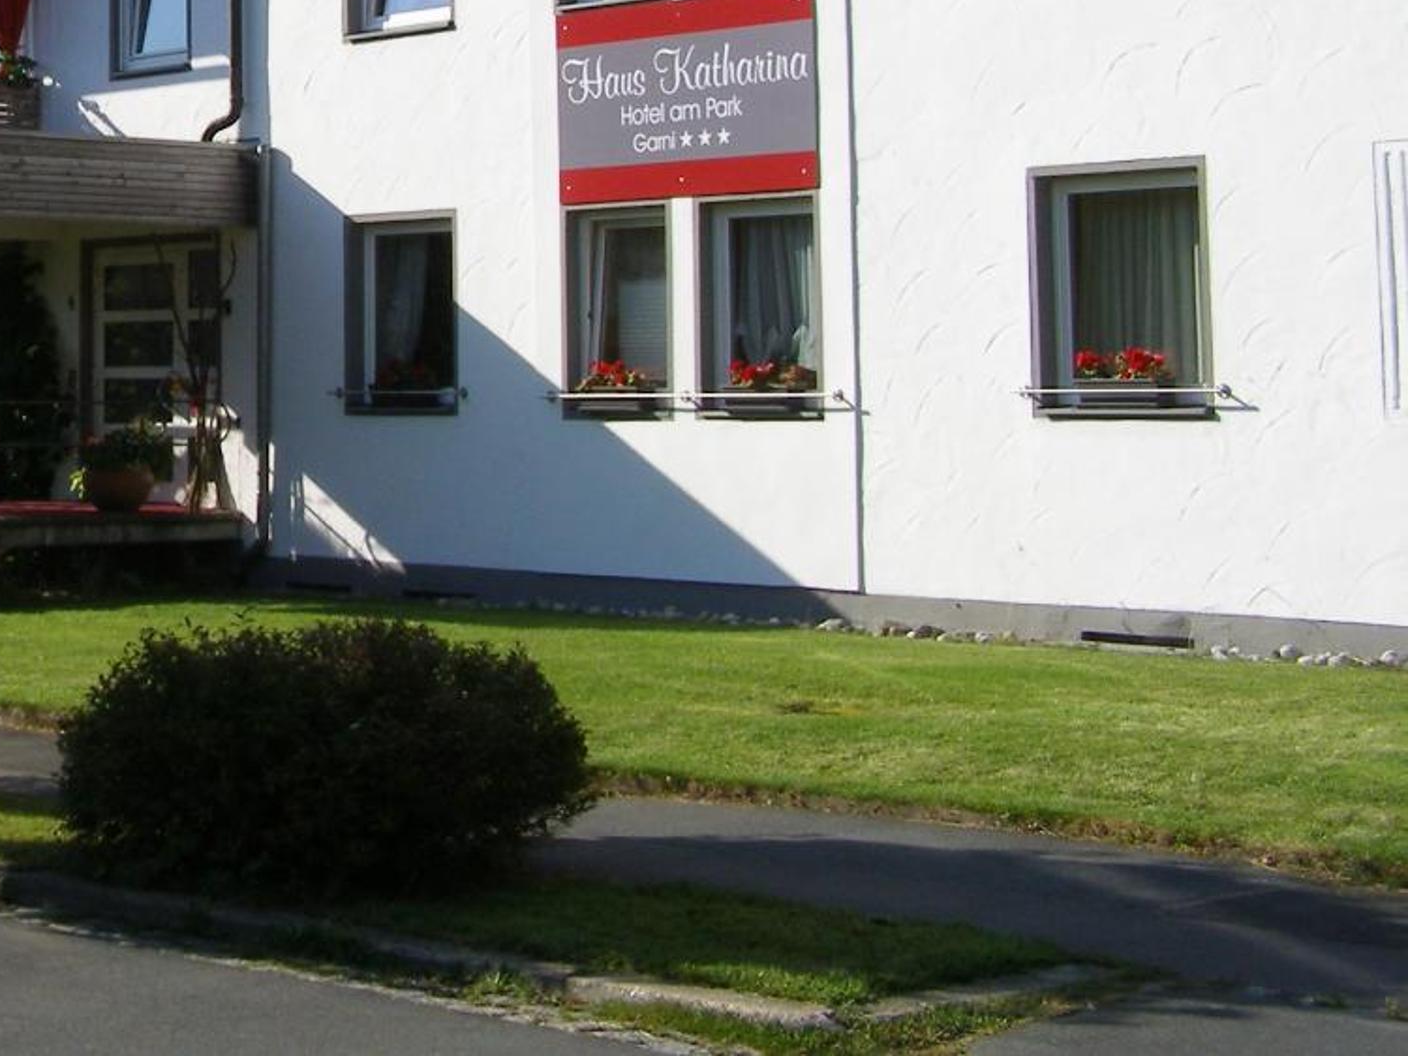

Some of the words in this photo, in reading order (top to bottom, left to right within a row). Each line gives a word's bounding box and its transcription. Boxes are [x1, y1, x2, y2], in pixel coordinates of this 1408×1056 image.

[561, 56, 646, 104] Haus
[654, 43, 807, 95] Katharina
[621, 104, 665, 126] Hotel
[669, 103, 701, 122] am
[705, 97, 742, 120] Park
[633, 132, 676, 153] Garni
